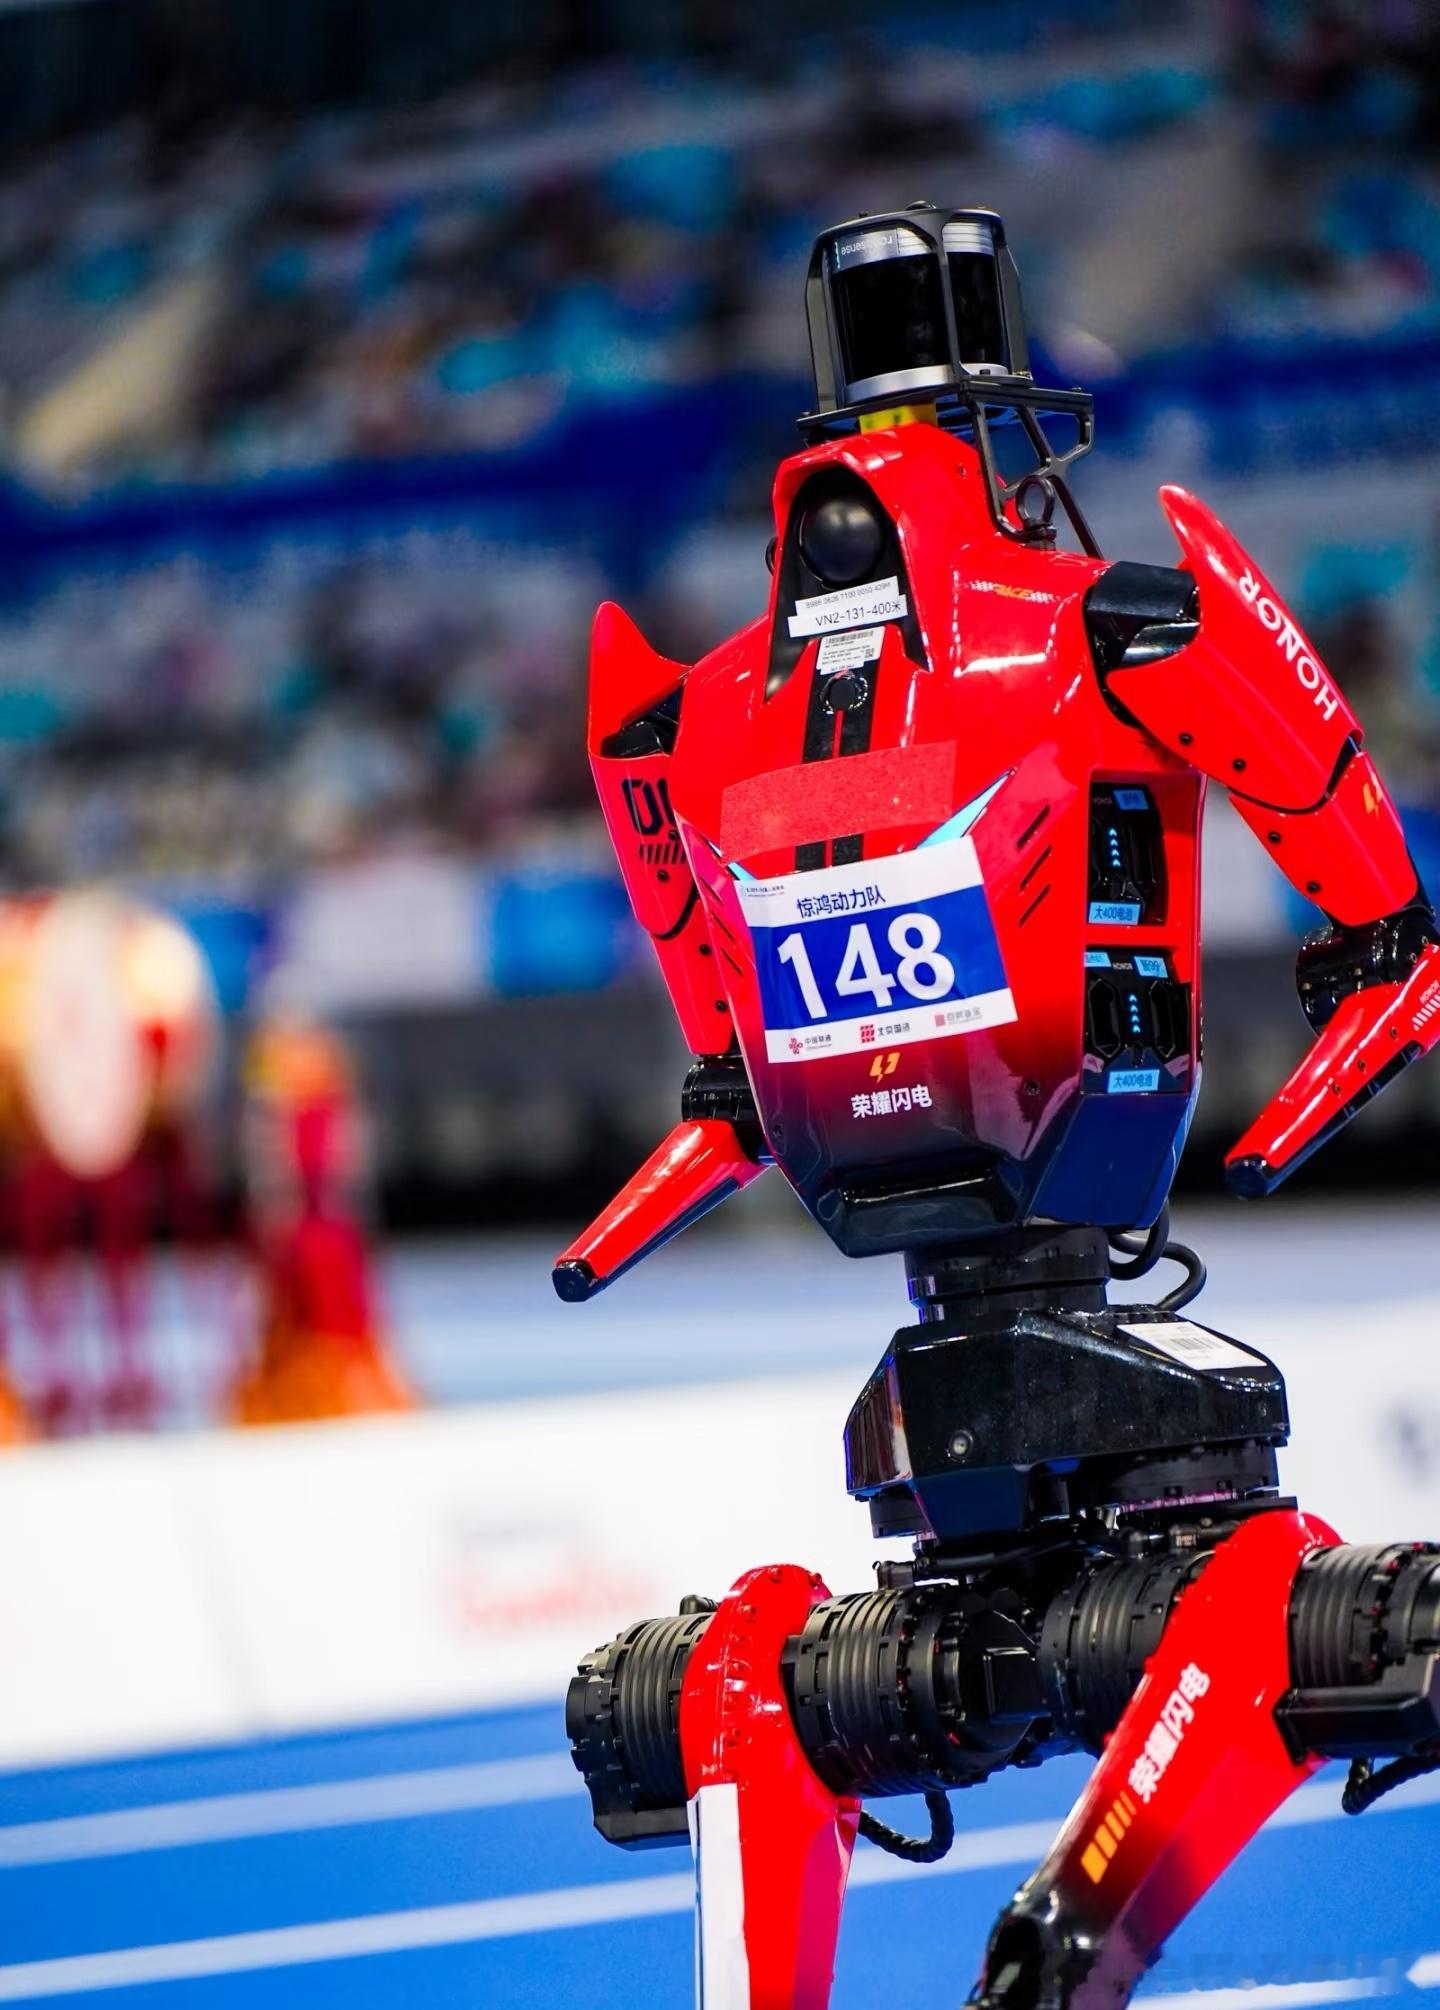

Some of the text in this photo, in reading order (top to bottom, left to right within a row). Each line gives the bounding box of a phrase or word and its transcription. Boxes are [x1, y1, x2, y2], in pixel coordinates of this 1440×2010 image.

[840, 235, 893, 255] rosense
[816, 601, 901, 626] VN2-131-400米
[1239, 568, 1339, 721] HONOR
[797, 885, 886, 919] 惊鸿动力队
[777, 912, 955, 1019] 148
[851, 1084, 933, 1119] 荣耀闪电
[1128, 1662, 1211, 1804] 荣耀闪电
